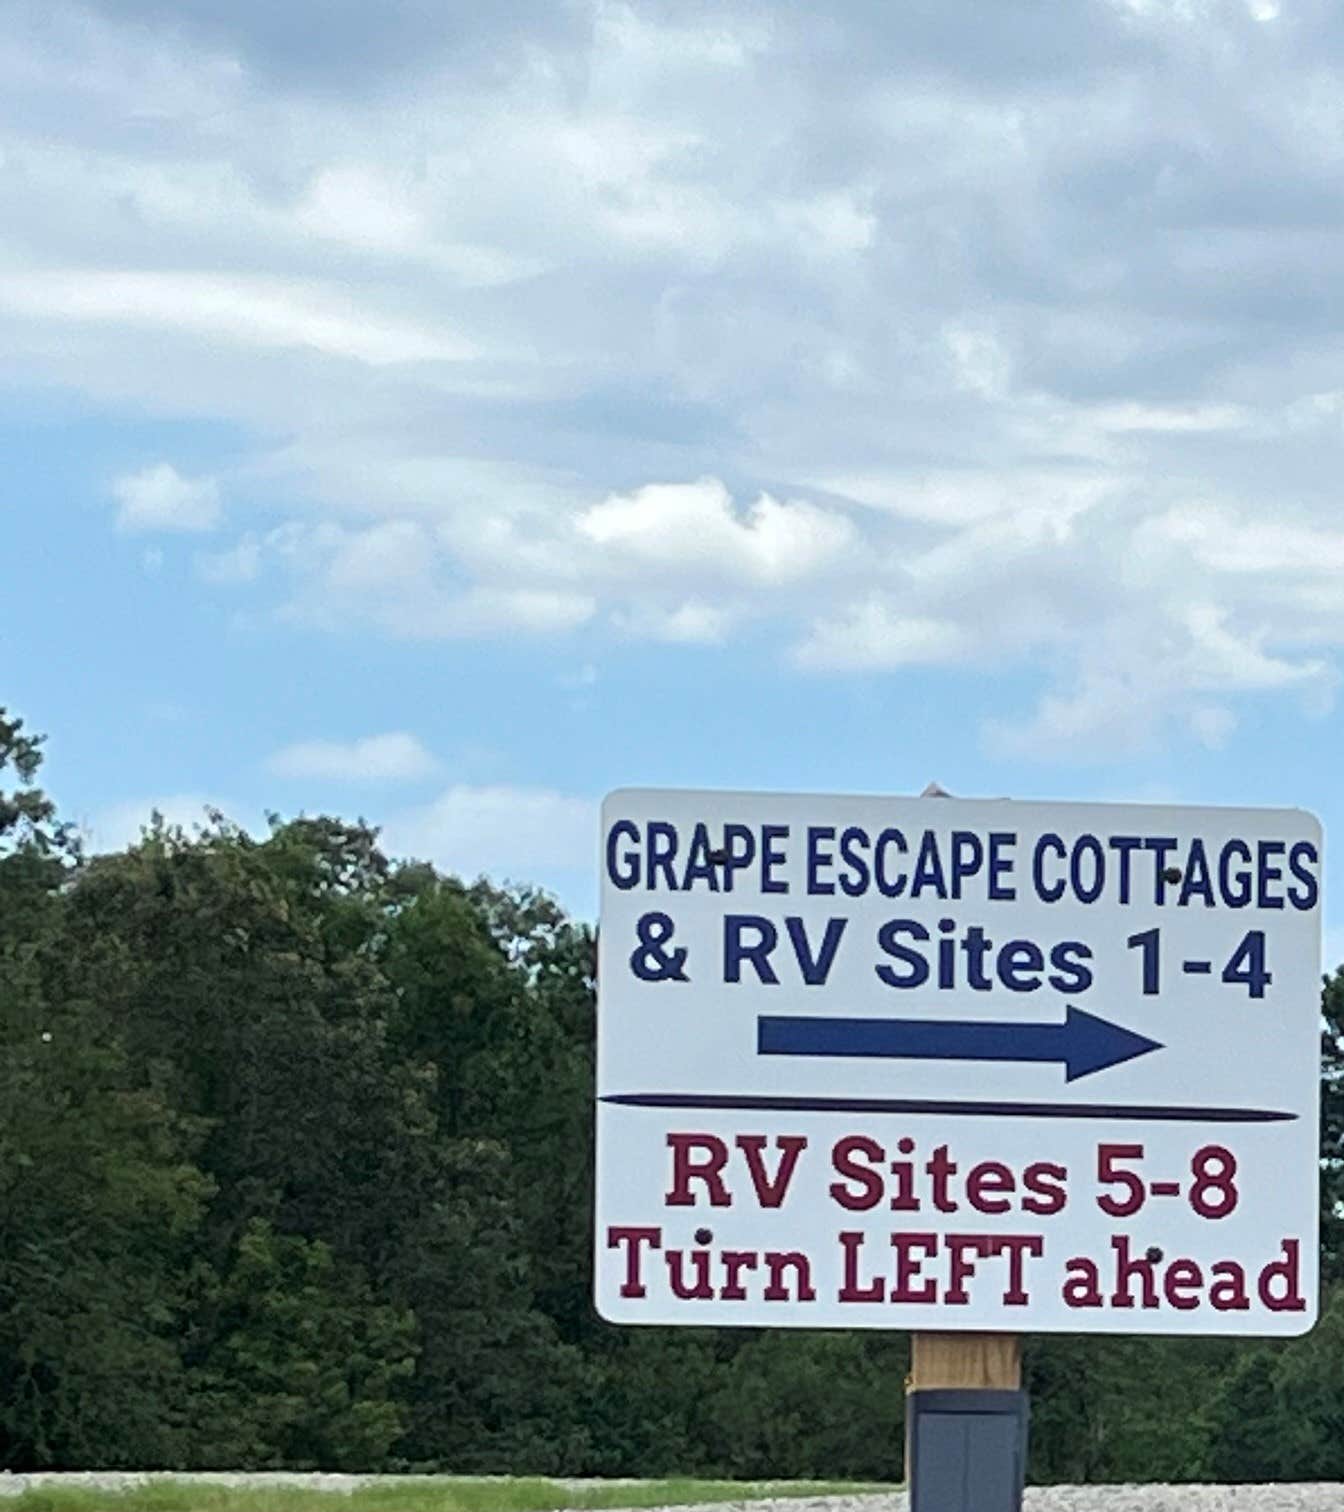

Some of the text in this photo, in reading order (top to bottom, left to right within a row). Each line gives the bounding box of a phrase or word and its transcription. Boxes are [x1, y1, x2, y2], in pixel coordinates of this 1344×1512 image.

[607, 820, 1319, 912] GRAPE ESCAPE COTTAGES
[630, 912, 1272, 998] & RV Sites 1-4
[665, 1133, 1239, 1220] RV Sites 5-8
[608, 1227, 1307, 1312] Turn LEFT ahead
